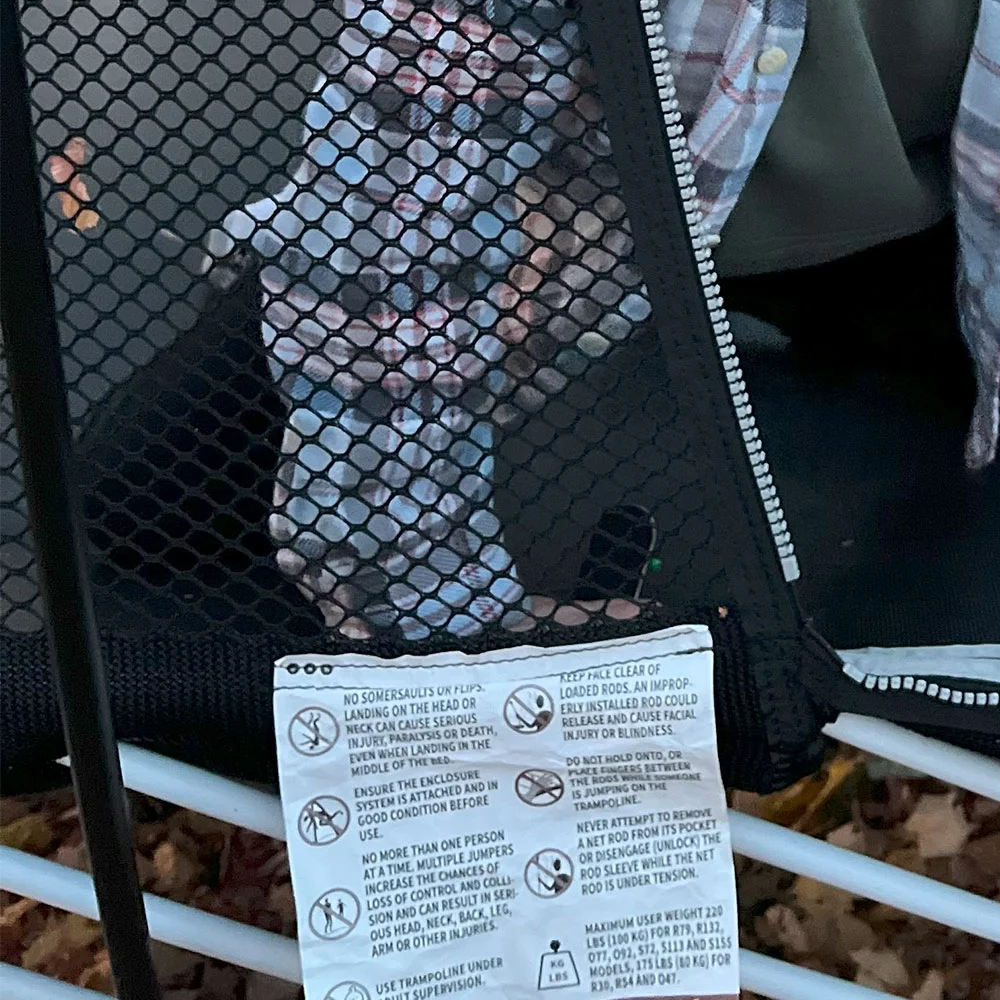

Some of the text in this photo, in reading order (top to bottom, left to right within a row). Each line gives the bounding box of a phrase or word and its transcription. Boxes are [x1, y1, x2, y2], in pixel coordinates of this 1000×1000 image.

[614, 664, 661, 678] CLEAR OF
[344, 687, 434, 705] NO SOMERSAULTS
[560, 678, 692, 699] LOADED RODS. AN IMPROP-
[345, 697, 476, 721] LANDING ON THE HEAD OR
[561, 694, 697, 715] ERLY INSTALLED ROD COULD
[347, 713, 477, 734] NECK CAN CAUSE SERIOUS
[562, 709, 696, 727] RELEASE AND CAUSE FACIAL
[348, 726, 497, 749] INJURY, PARALYSIS OR DEATH,
[564, 725, 676, 741] INJURY OR BLINDNESS.
[350, 739, 490, 764] EVEN WHEN LANDING IN THE
[567, 751, 681, 766] DO NOT HOLD ONTO, OR
[352, 759, 428, 777] MIDDLE OF THE
[645, 762, 690, 773] BETWEEN
[355, 770, 480, 798] ENSURE THE ENCLOSURE
[356, 781, 498, 812] SYSTEM IS ATTACHED AND IN
[572, 782, 667, 799] IS JUMPING ON THE
[358, 795, 489, 826] GOOD CONDITION BEFORE
[575, 795, 641, 811] TRAMPOLINE.
[577, 808, 712, 833] NEVER ATTEMPT TO REMOVE
[360, 829, 383, 841] USE.
[578, 819, 716, 849] A NET ROD FROM ITS POCKET
[362, 831, 505, 864] NO MORE THAN ONE PERSON
[580, 832, 721, 864] OR DISENGAGE (UNLOCK) THE
[364, 844, 513, 880] AT A TIME. MULTIPLE JUMPERS
[581, 848, 714, 880] ROD SLEEVE WHILE THE NET
[365, 862, 500, 895] INCREASE THE CHANCES OF
[582, 869, 698, 895] ROD IS UNDER TENSION.
[367, 882, 480, 911] LOSS OF CONTROL AND
[369, 893, 491, 926] SION AND CAN RESULT IN
[586, 905, 723, 934] MAXIMUM USER WEIGHT 220
[371, 905, 512, 941] OUS HEAD, NECK, BACK, LEG,
[372, 921, 497, 957] ARM OR OTHER INJURIES.
[377, 958, 503, 995] USE TRAMPOLINE UNDER
[413, 976, 485, 1000] SUPERVISION.
